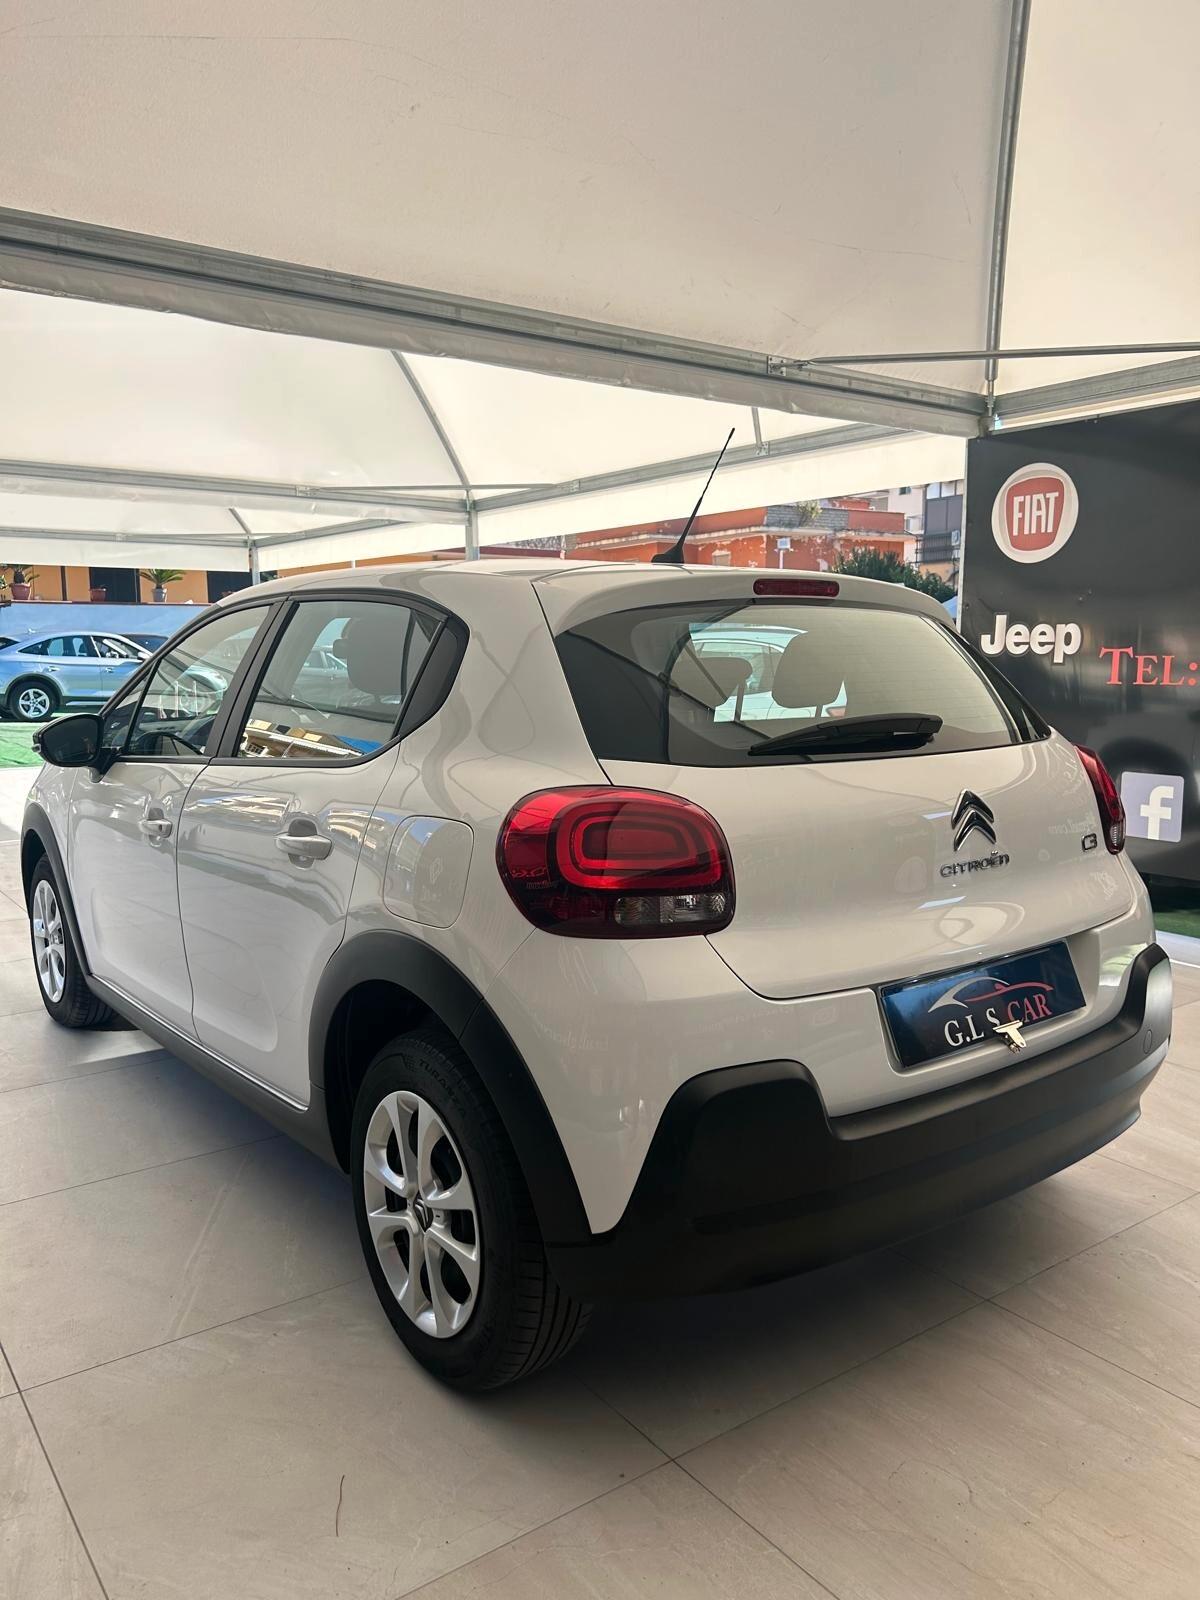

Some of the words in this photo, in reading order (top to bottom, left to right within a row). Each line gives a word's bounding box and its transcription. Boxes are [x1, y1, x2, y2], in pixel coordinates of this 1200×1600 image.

[1013, 492, 1059, 536] FIAT
[980, 614, 1082, 663] Jeep
[1099, 646, 1199, 686] TEL:
[1007, 993, 1053, 1025] CAR
